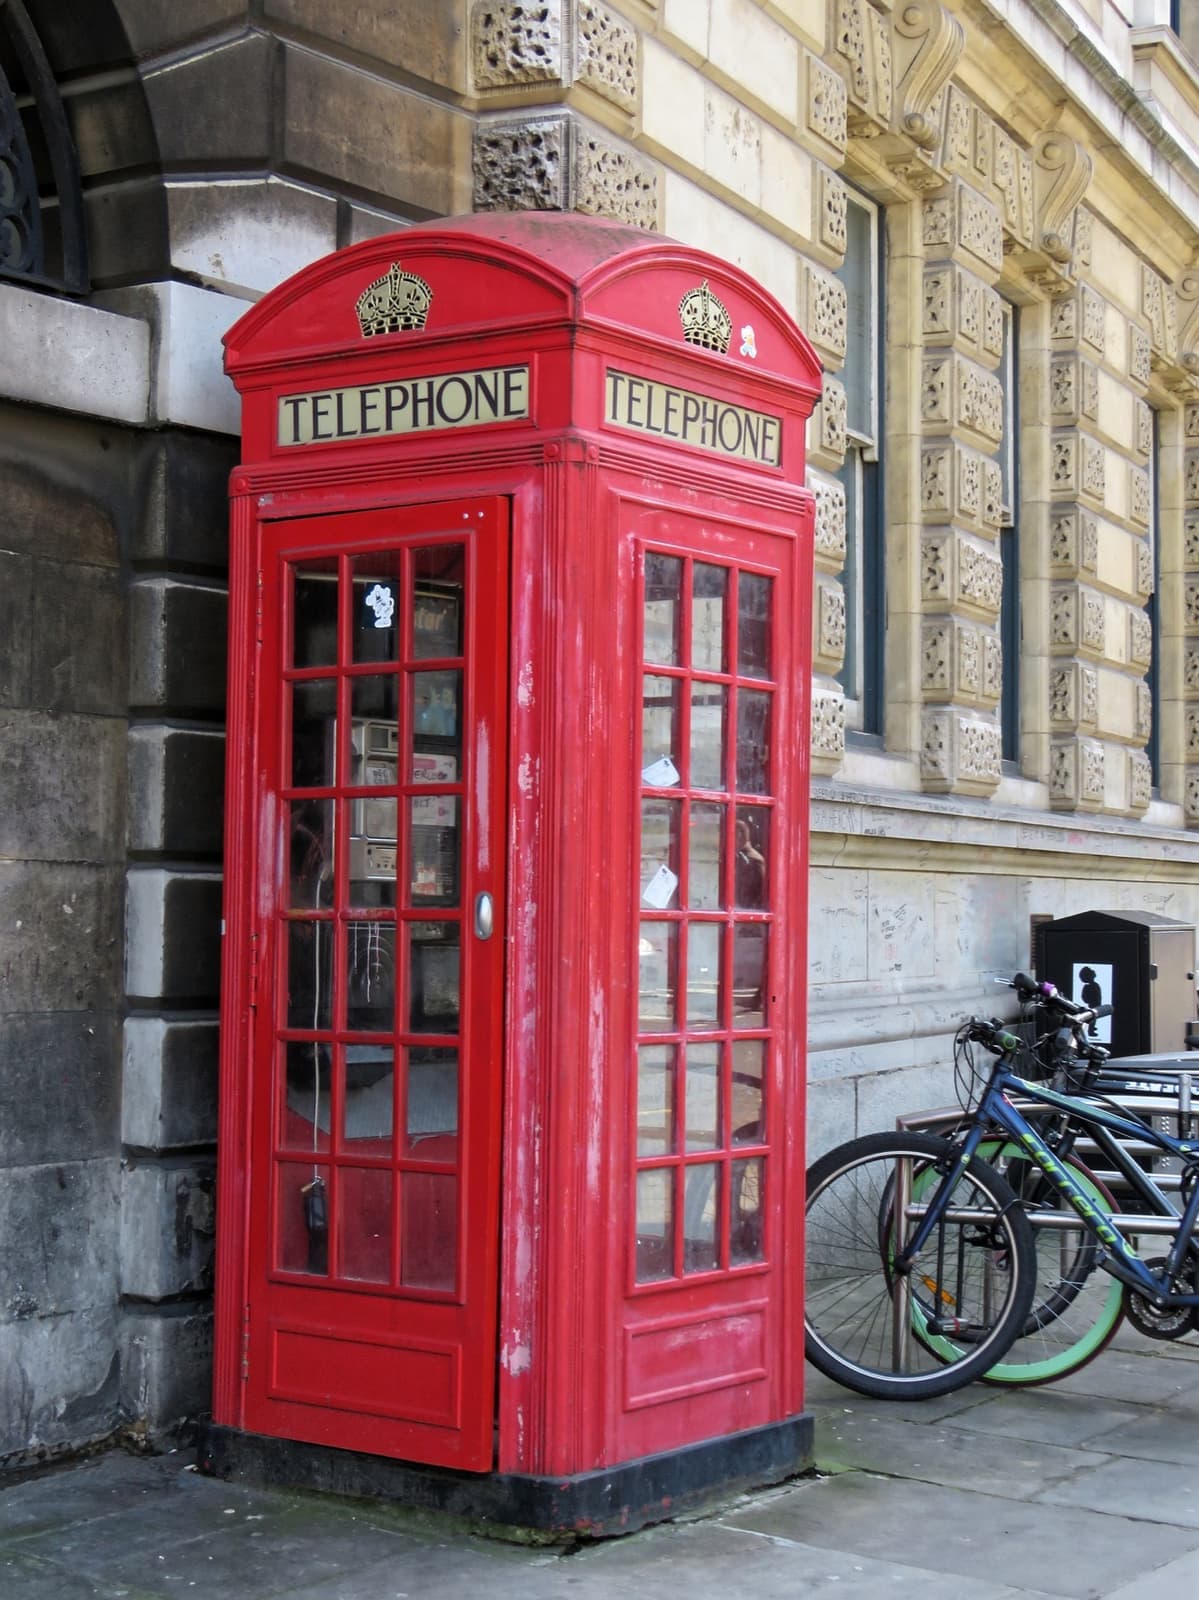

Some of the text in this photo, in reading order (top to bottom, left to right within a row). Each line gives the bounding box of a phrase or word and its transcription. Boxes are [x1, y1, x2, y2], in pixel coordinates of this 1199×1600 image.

[284, 368, 527, 442] TELEPHONE
[606, 372, 777, 464] TELEPHONE
[1019, 1132, 1118, 1243] carrera
